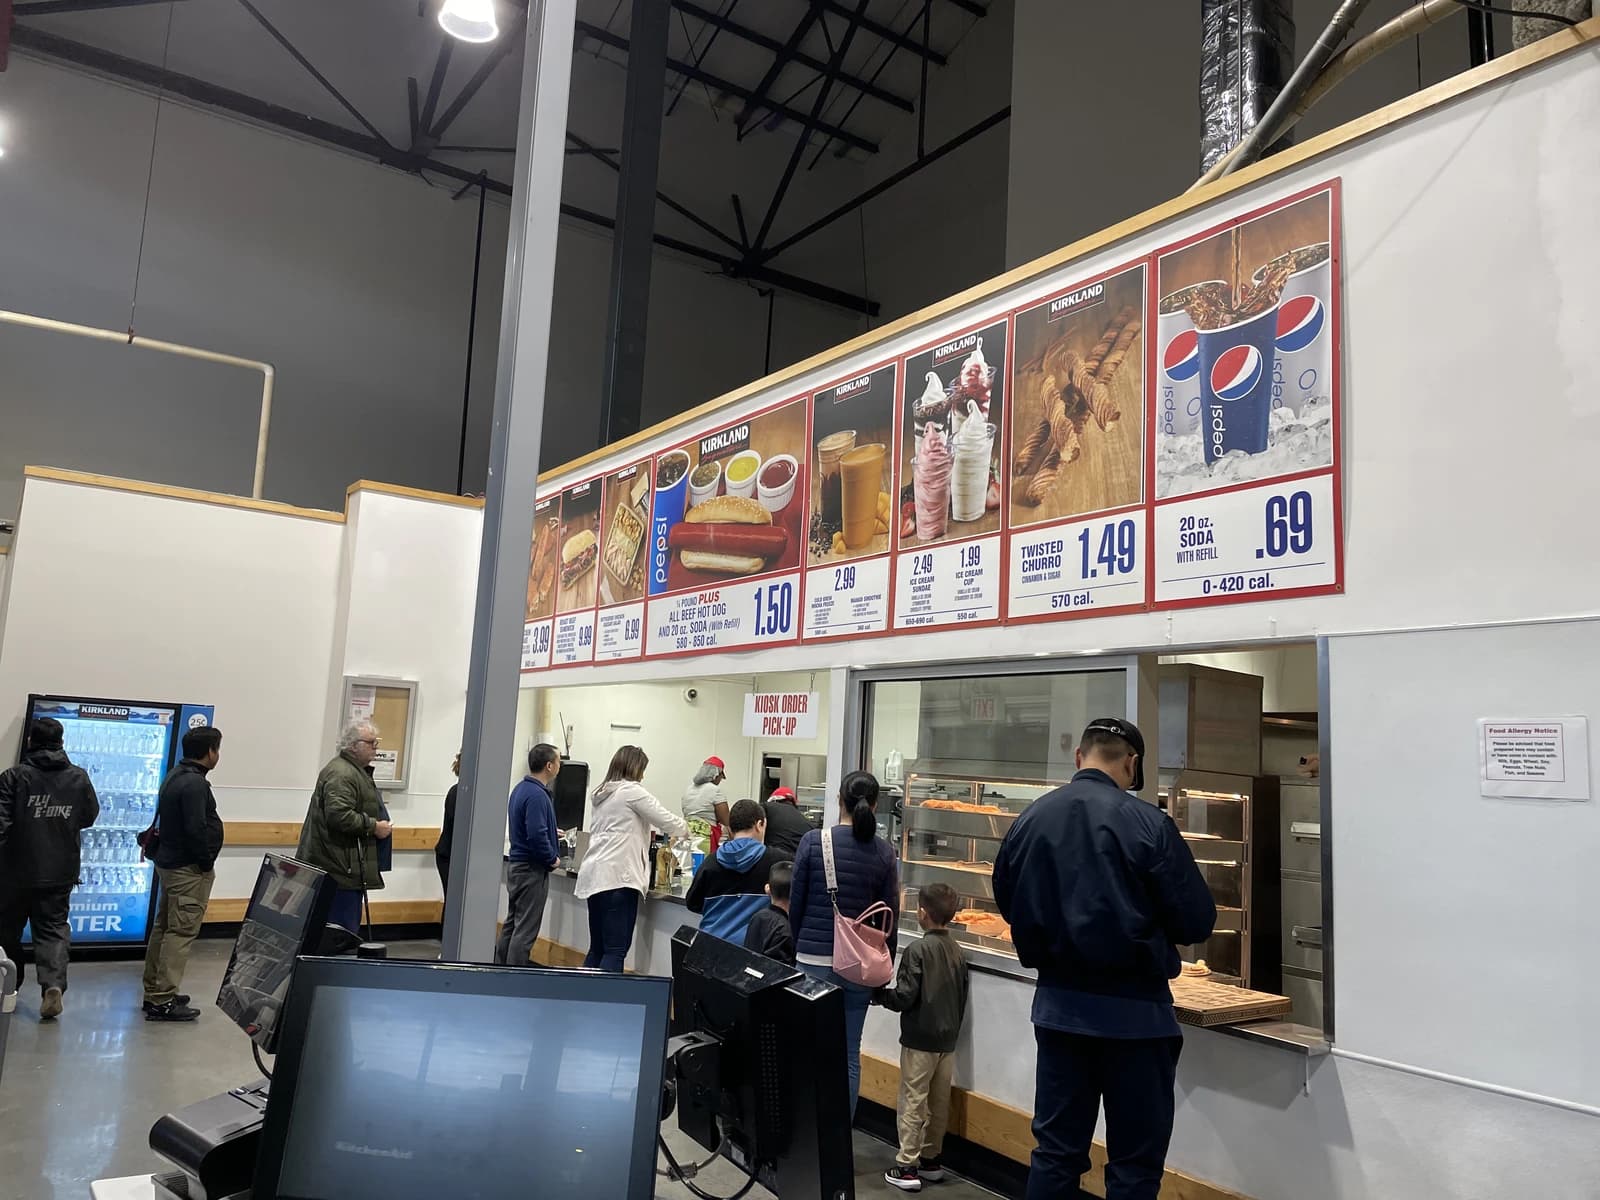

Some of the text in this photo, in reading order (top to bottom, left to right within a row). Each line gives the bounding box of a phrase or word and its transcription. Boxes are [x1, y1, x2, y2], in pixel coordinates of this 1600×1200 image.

[1051, 284, 1103, 313] KIRKLAND
[935, 335, 977, 359] KIRKLAND
[836, 376, 870, 396] KIRKLAND
[1162, 386, 1176, 435] pepsi
[701, 425, 749, 455] KIRKLAND
[1210, 404, 1226, 458] pepsi
[1179, 516, 1213, 532] 20 oz.
[1256, 491, 1313, 559] .69
[1180, 530, 1214, 548] SODA
[656, 516, 668, 583] pepsi
[960, 545, 980, 568] 1.99
[1021, 540, 1063, 559] TWISTED
[1078, 519, 1135, 579] 1.49
[1176, 547, 1218, 564] WITH REFILL
[913, 553, 933, 576] 2.49
[964, 568, 983, 577] CREAM
[1022, 554, 1061, 573] CHURRO
[834, 566, 856, 591] 2.99
[912, 584, 931, 592] SUNDAE
[918, 576, 935, 584] CREAM
[963, 578, 974, 586] CUP
[1249, 573, 1274, 589] cal.
[682, 597, 697, 607] POUND
[698, 591, 720, 604] PLUS
[1052, 591, 1094, 608] 570 cal.
[669, 603, 726, 623] ALL BEEF HOT DOG
[754, 582, 792, 636] 1.50
[658, 618, 740, 638] AND 20 oz. SODA (With Refill)
[532, 625, 550, 654] 3.99
[693, 635, 704, 647] 850
[706, 634, 717, 645] cal.
[81, 706, 128, 715] KIRKLAND
[754, 694, 808, 713] KIOSK ORDER
[762, 716, 797, 736] PICK-UP
[27, 794, 50, 808] FLY
[70, 899, 118, 911] mium
[72, 915, 122, 932] TER
